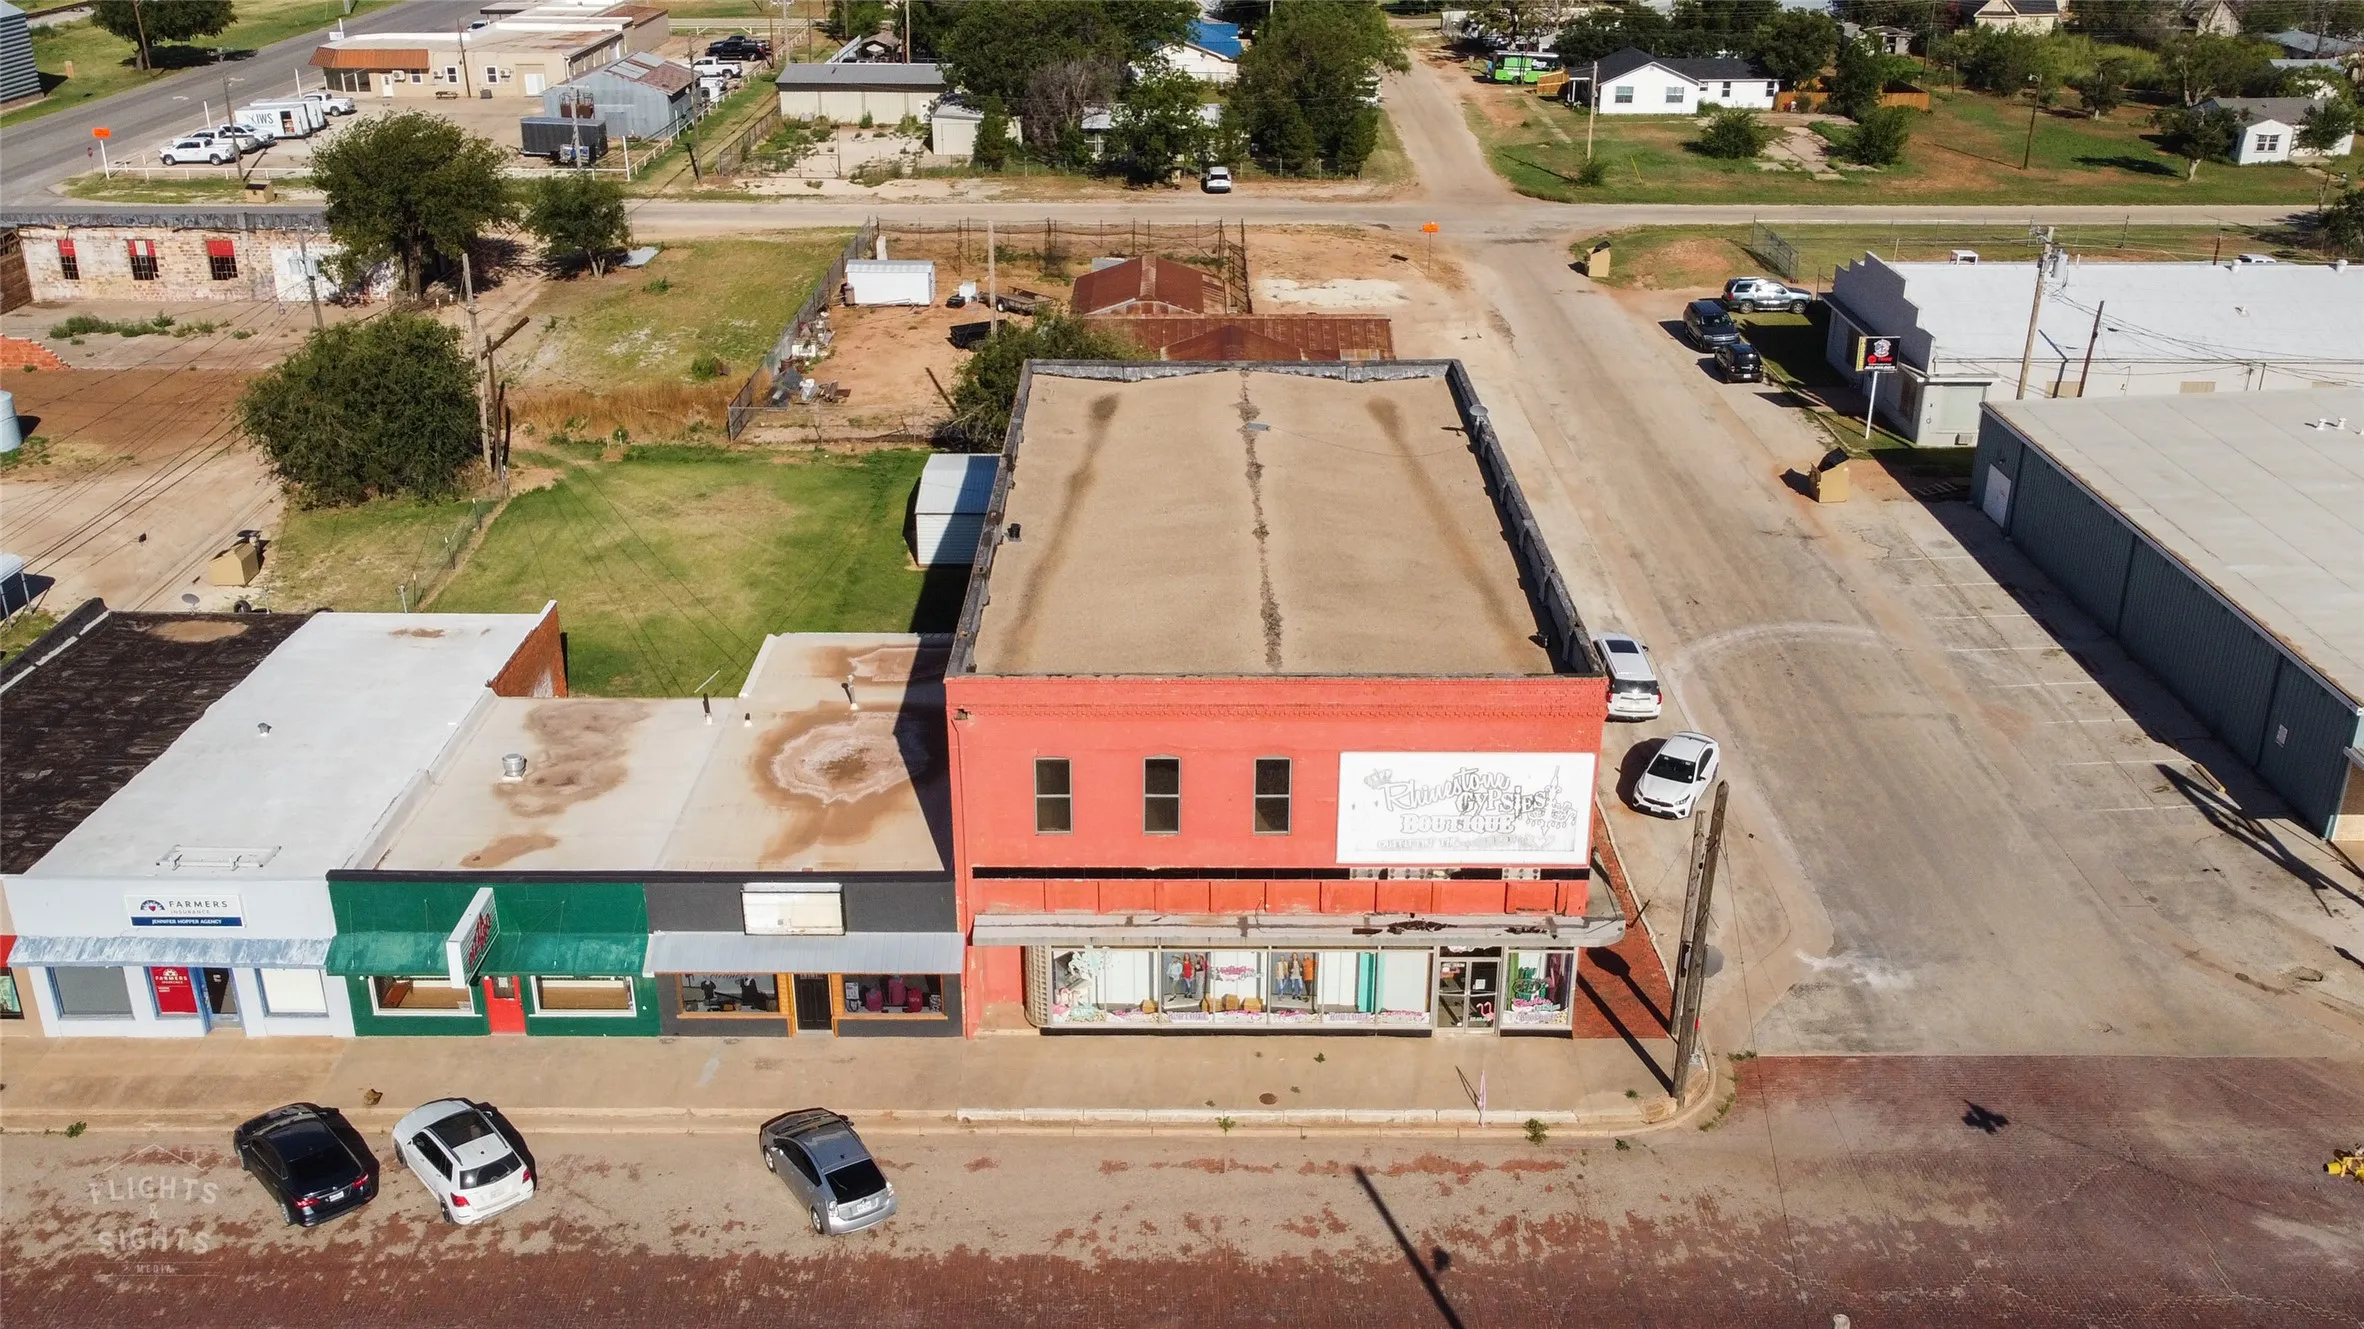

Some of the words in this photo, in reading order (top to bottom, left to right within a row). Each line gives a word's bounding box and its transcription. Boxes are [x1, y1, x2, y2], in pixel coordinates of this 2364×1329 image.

[1378, 767, 1511, 812] Rhinestone
[1400, 813, 1516, 835] BOUTIQUE
[168, 900, 229, 908] FARMERS
